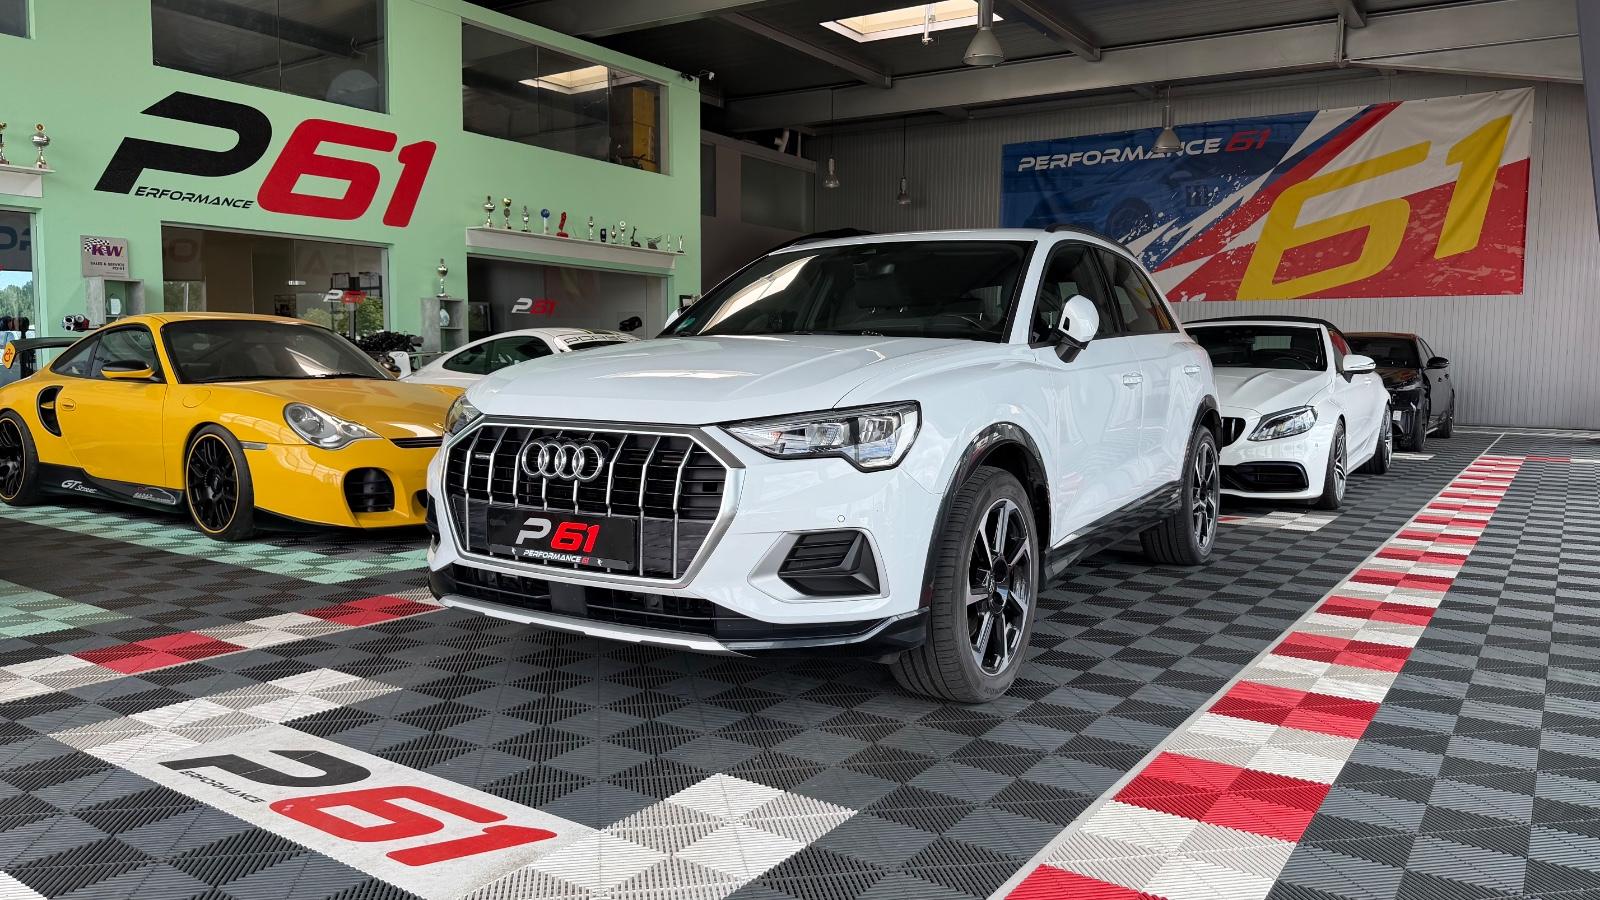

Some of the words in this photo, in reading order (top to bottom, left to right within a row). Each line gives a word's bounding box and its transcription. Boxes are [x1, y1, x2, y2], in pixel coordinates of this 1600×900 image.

[1225, 128, 1272, 152] 61
[94, 91, 437, 227] P61
[135, 186, 254, 209] ERFORMANCE
[1237, 114, 1512, 300] 61
[91, 244, 123, 257] KW
[61, 480, 82, 489] GT
[515, 517, 600, 553] P61
[523, 549, 581, 563] PERFORMANCE
[157, 749, 558, 867] P61
